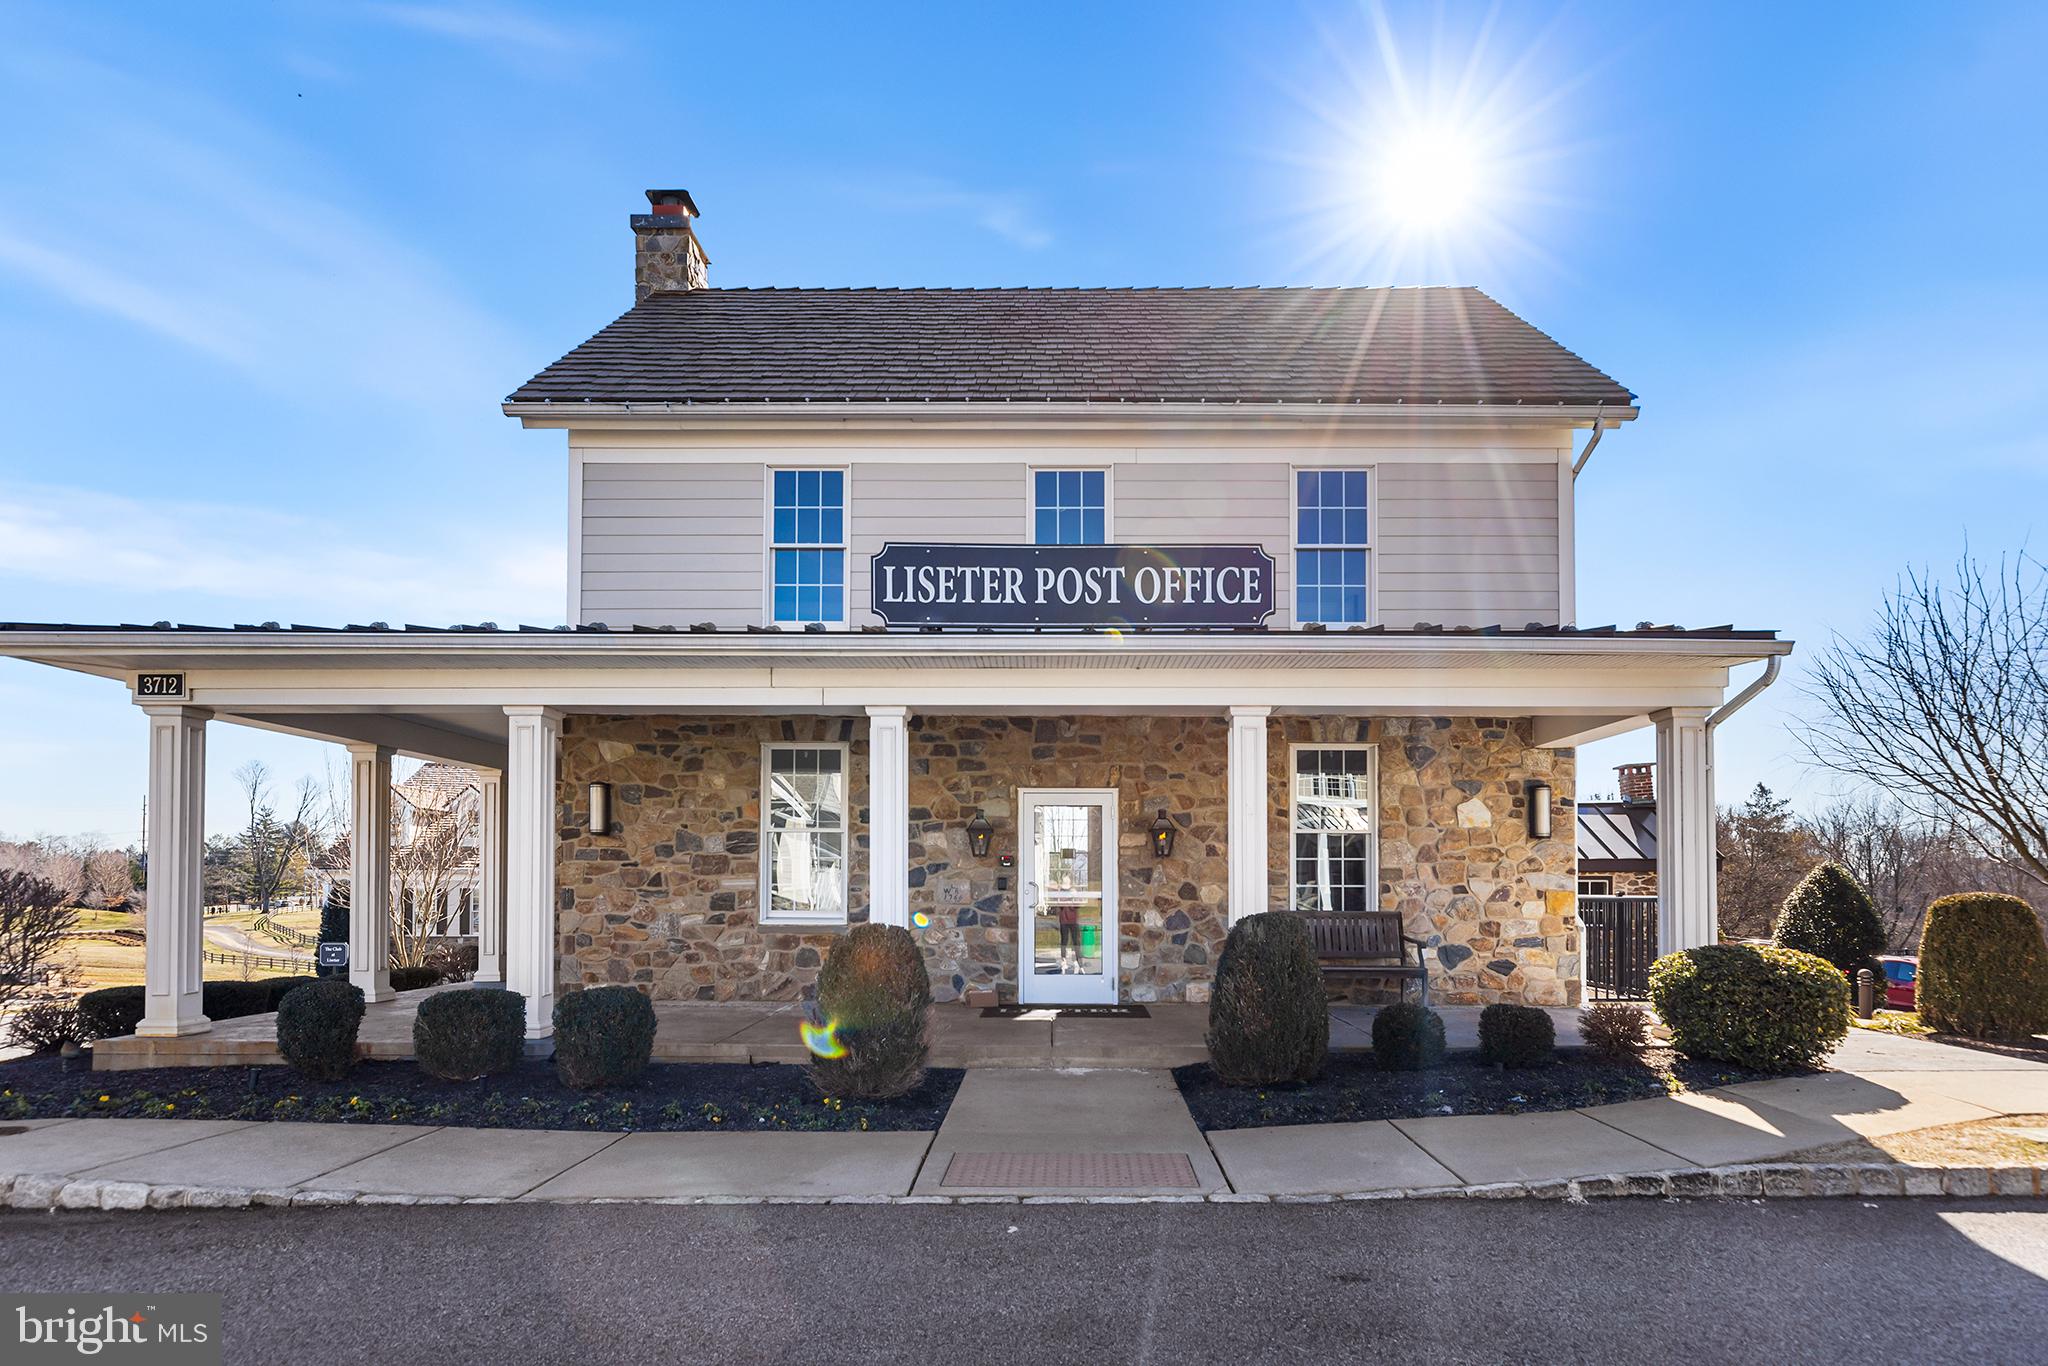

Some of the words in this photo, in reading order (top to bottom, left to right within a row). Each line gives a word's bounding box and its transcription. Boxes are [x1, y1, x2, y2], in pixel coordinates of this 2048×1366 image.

[883, 566, 1026, 604] LISETER
[1034, 567, 1126, 604] POST
[1134, 566, 1262, 604] OFFICE
[143, 676, 178, 694] 3712
